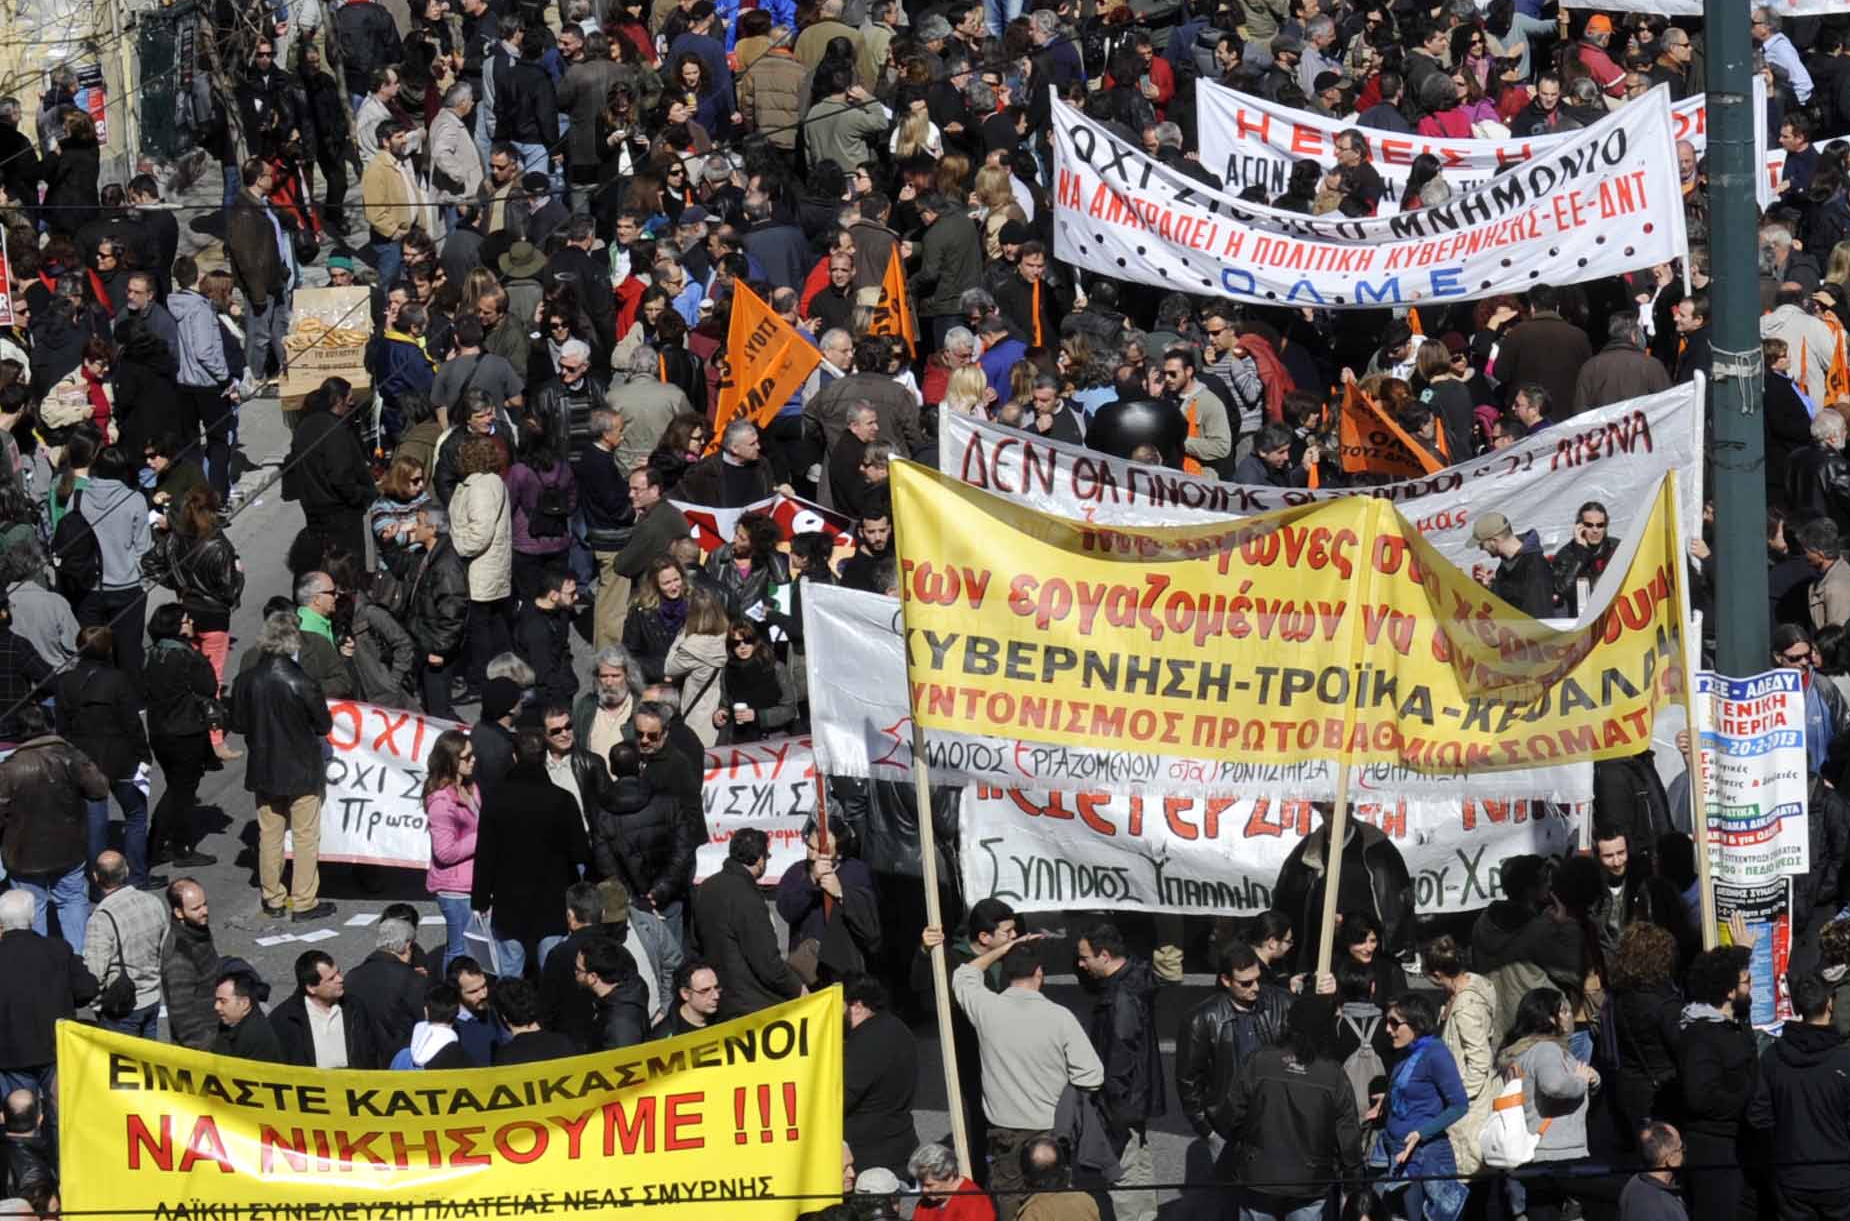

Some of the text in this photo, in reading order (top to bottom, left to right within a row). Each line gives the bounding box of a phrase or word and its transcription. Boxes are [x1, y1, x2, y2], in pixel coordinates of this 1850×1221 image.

[1237, 109, 1532, 166] Η Η
[1070, 124, 1628, 239] ΟΧΙ ΜΝΗΜΟΝΙΟ
[1058, 169, 1081, 212] ΝΑ
[1088, 181, 1219, 252] ΑΝΑΤΡΑΠΕΙ
[1224, 230, 1246, 259] Η
[1251, 235, 1375, 272] ΠΟΛΙΤΙΚΗ
[960, 430, 1057, 495] ΔΕΝ
[1072, 456, 1120, 504] ΘΑ
[1416, 507, 1469, 533] μας
[1008, 571, 1347, 647] εργαζομένων
[1361, 602, 1416, 657] να
[1745, 674, 1796, 699] ΑΔΕΔΥ
[330, 700, 426, 763] ΟΧΙ
[327, 754, 386, 795] ΟΧΙ
[109, 1017, 810, 1118] ΕΙΜΑΣΤΕ ΚΑΤΑΔΙΚΑΣΜΕΝΟΙ
[126, 1081, 801, 1175] ΝΑ ΝΙΚΗΣΟΥΜΕ !!!
[424, 1192, 555, 1221] ΠΛΑΤΕΙΑΣ
[564, 1186, 634, 1211] ΝΕΑΣ
[643, 1175, 775, 1206] ΣΜΥΡΝΗΣ
